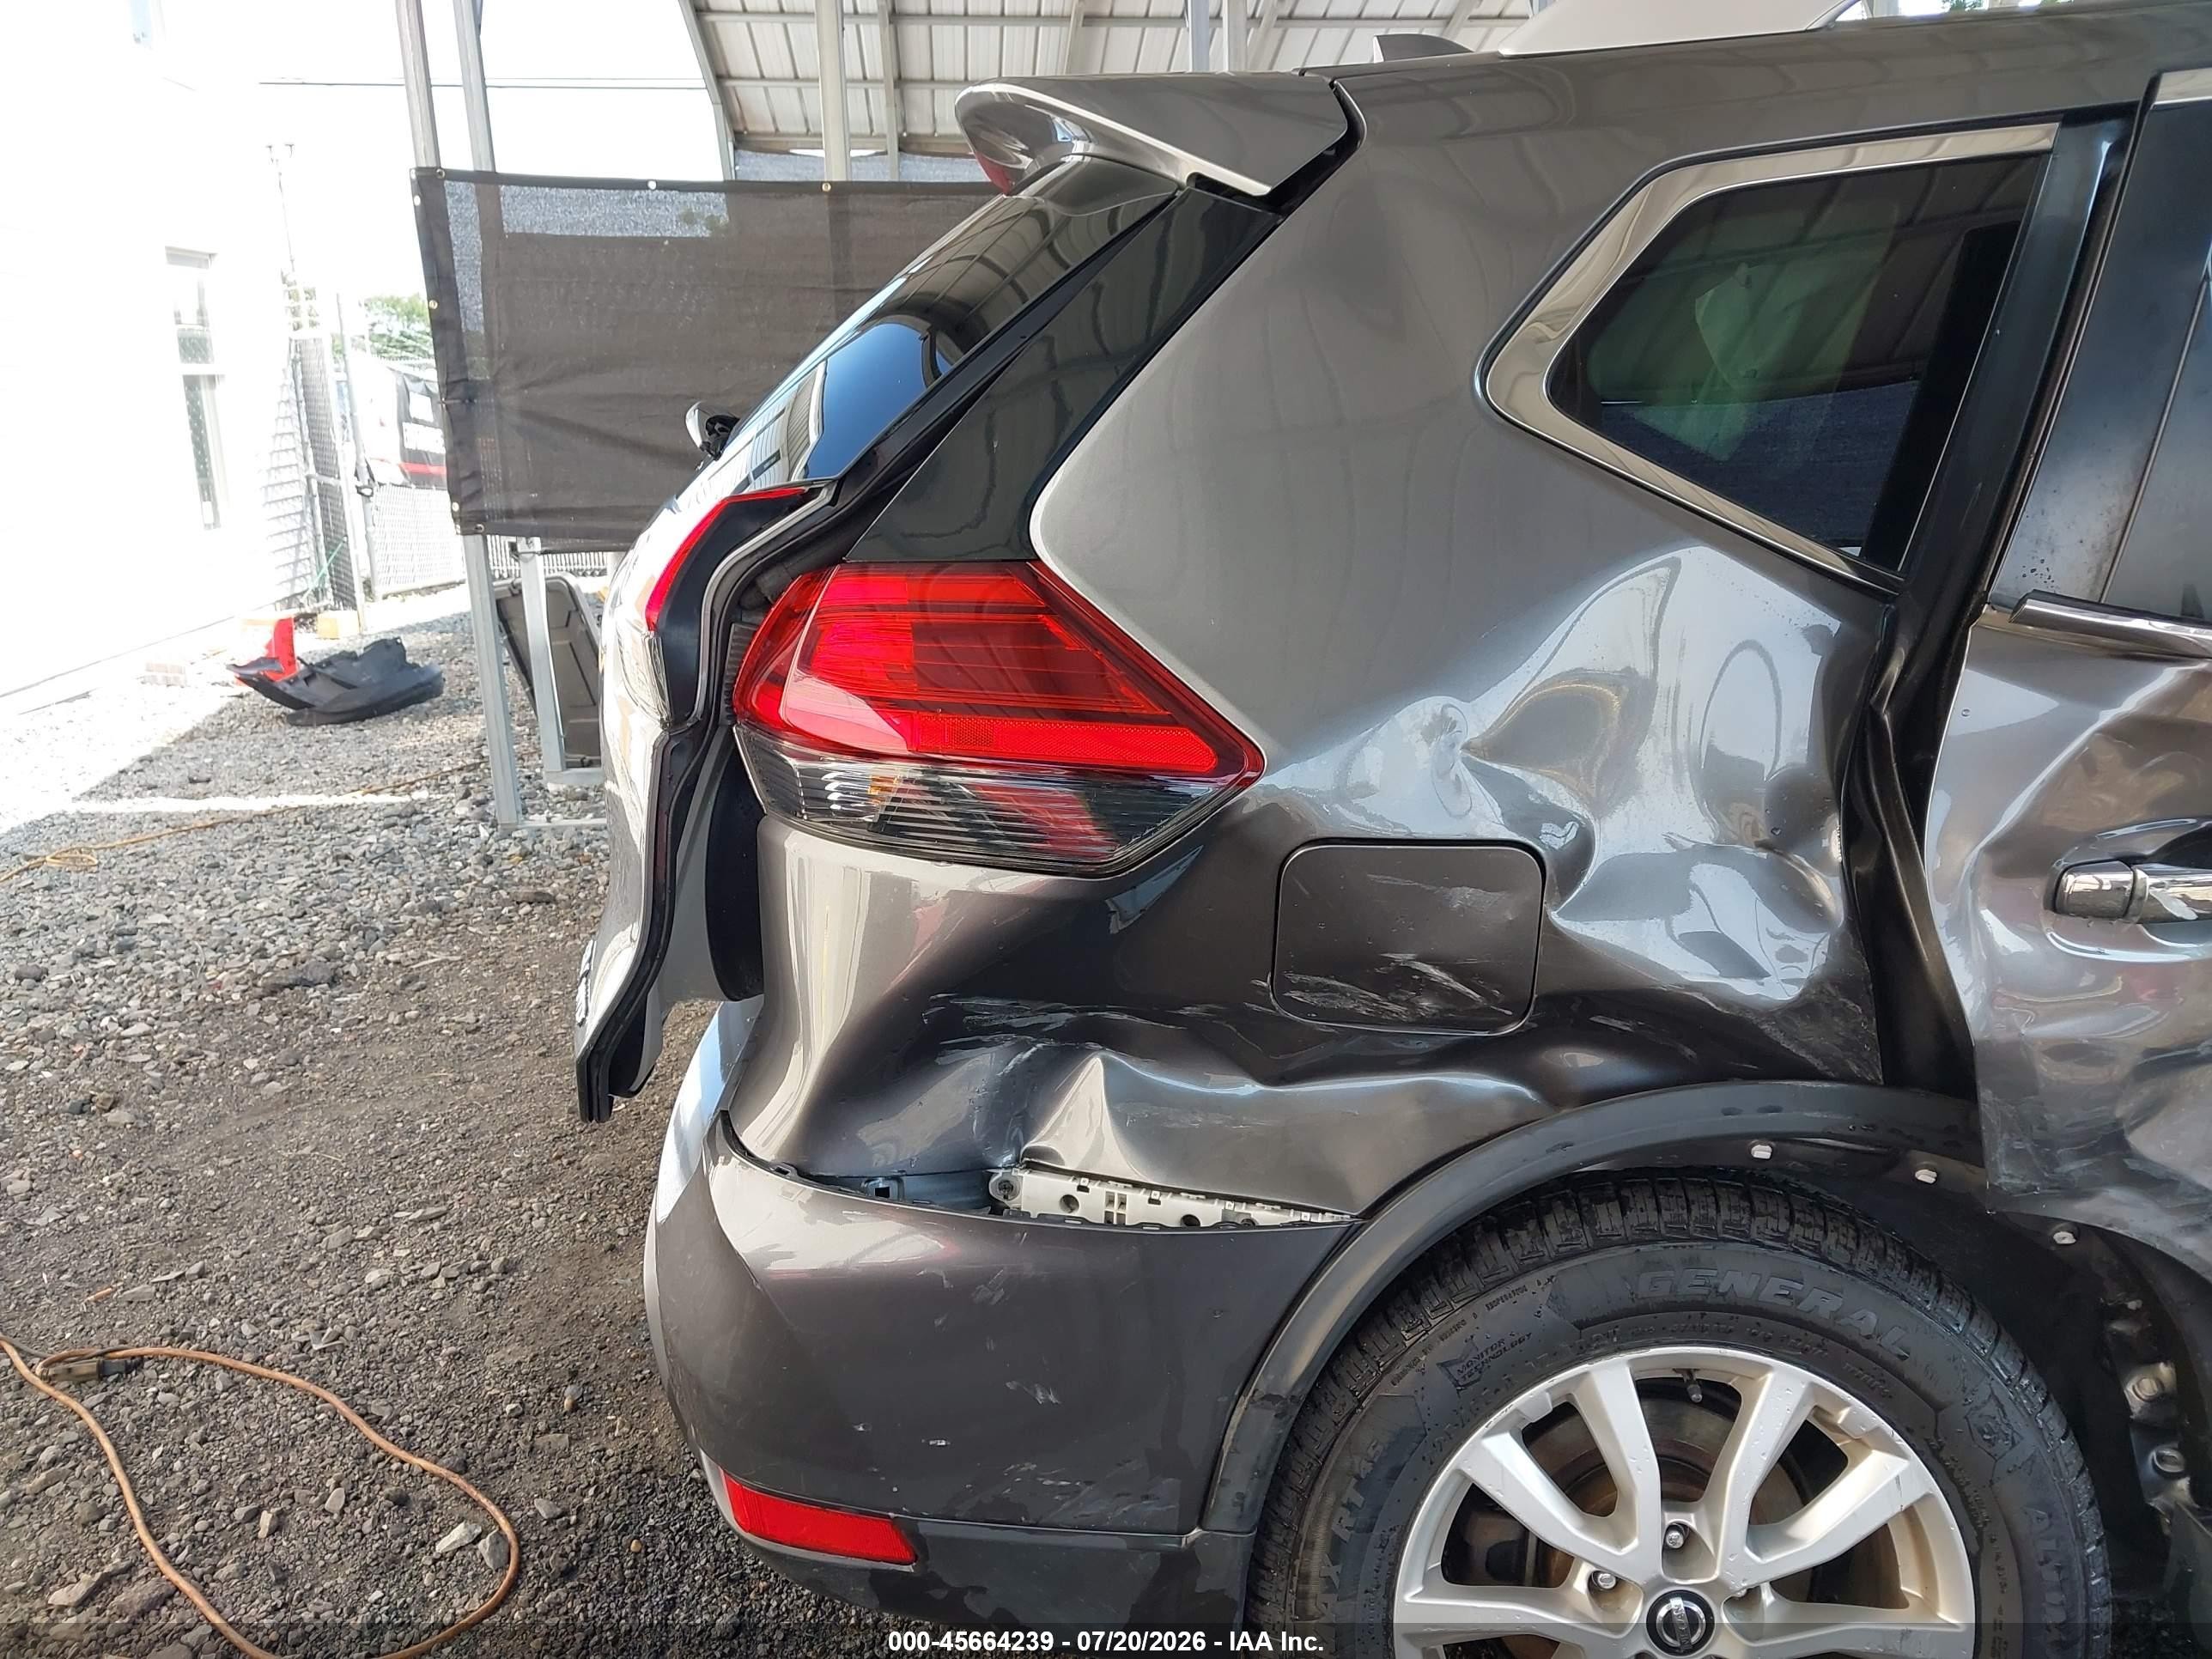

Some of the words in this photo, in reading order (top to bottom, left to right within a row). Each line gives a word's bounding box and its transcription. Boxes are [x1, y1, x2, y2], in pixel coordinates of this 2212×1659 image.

[1636, 1267, 1911, 1361] GENERAL
[1456, 1338, 1506, 1376] MONITOR
[1460, 1332, 1532, 1382] TECHNOLOGY
